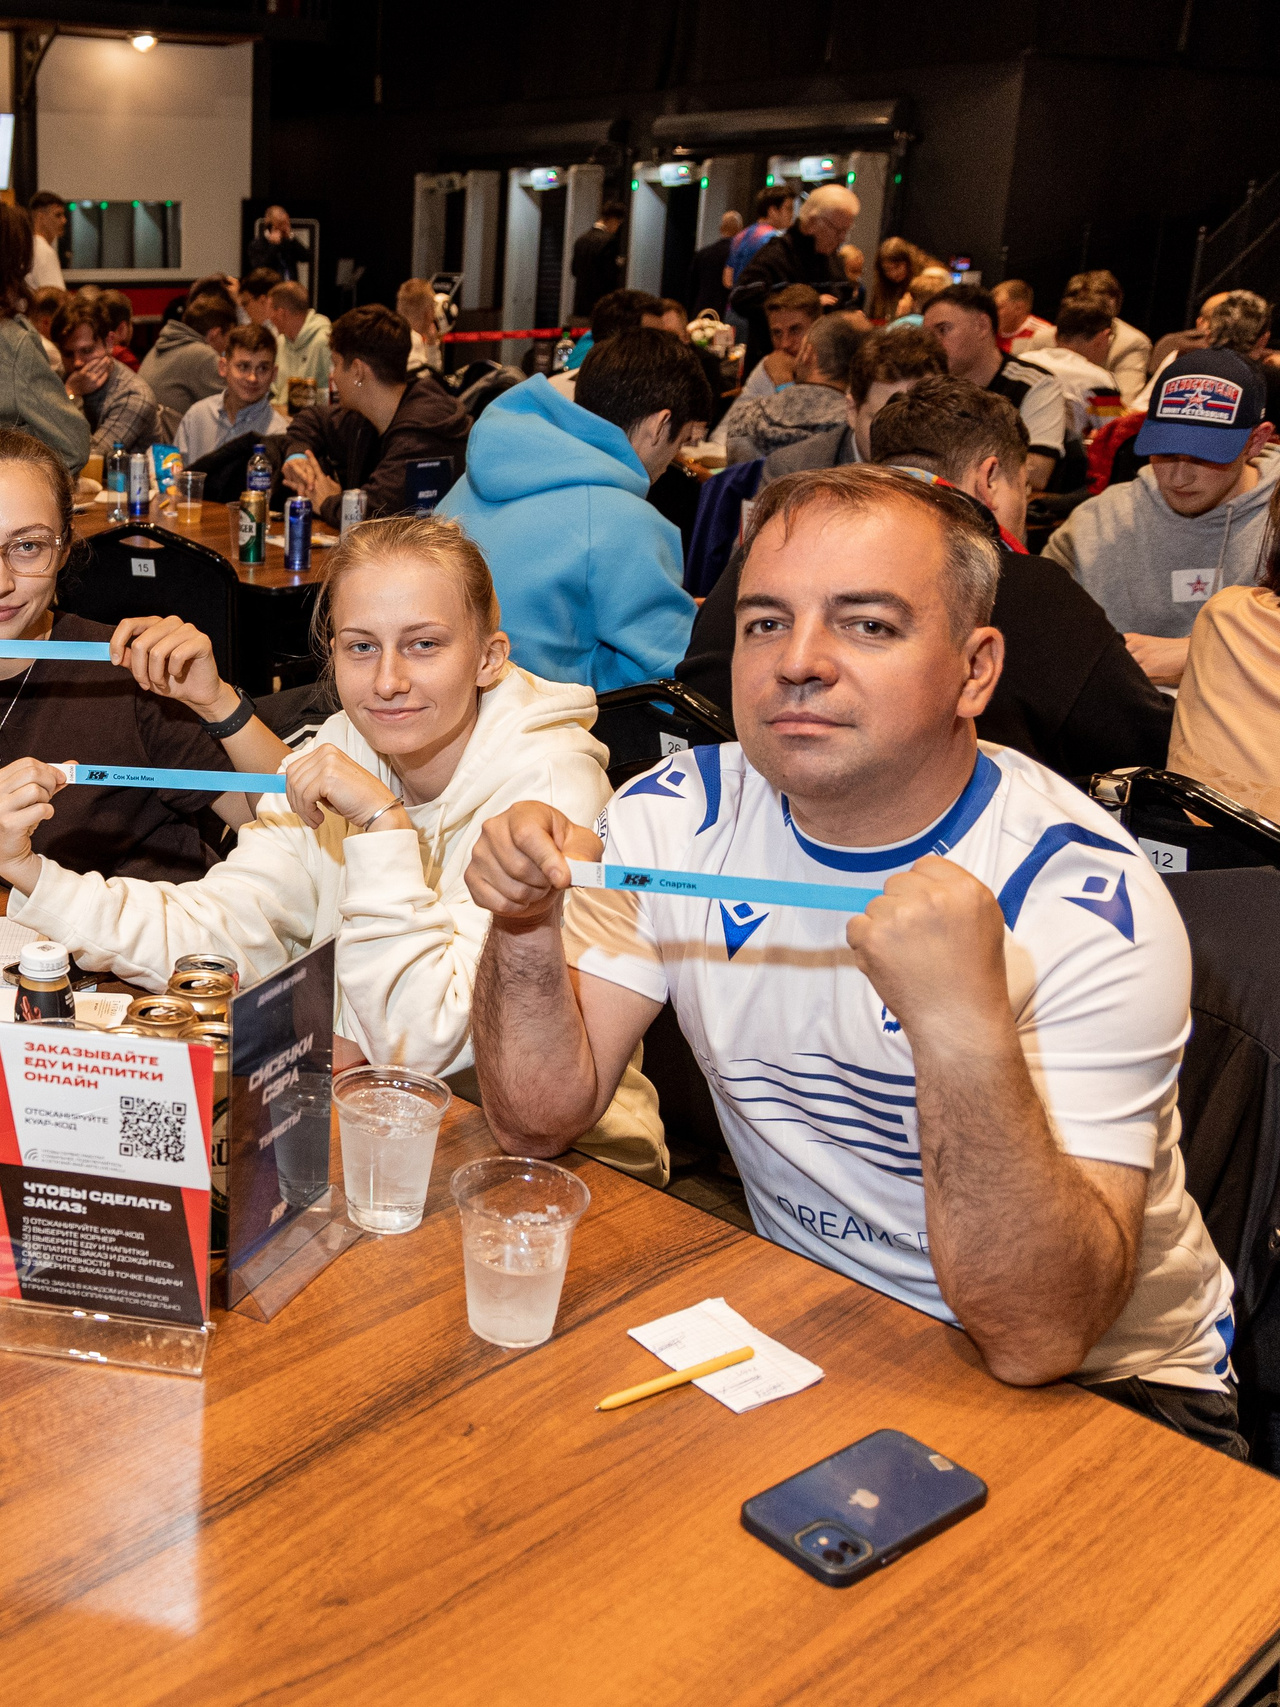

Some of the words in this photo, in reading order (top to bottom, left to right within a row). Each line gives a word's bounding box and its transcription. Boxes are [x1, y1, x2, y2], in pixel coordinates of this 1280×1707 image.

[138, 563, 149, 572] 15
[668, 742, 681, 754] 26
[1151, 850, 1173, 868] 12
[659, 879, 697, 890] Спартак
[24, 1042, 159, 1066] ЗАКАЗЫВАЙТЕ
[24, 1057, 61, 1069] ЕДУ
[62, 1062, 73, 1071] И
[77, 1063, 163, 1082] НАПИТКИ
[24, 1071, 99, 1090] ОНЛАЙН
[262, 1066, 300, 1105] СЭРА
[24, 1107, 109, 1125] ОТСКАНИРУЙТЕ
[24, 1117, 77, 1131] КУАР-КОД
[23, 1181, 87, 1200] ЧТОБЫ
[89, 1191, 172, 1212] СДЕЛАТЬ
[23, 1196, 88, 1215] ЗАКАЗ:
[29, 1217, 100, 1233] ОТСКАНИРУЙТЕ
[100, 1227, 145, 1241] КУАР-КОД
[32, 1226, 79, 1237] ВЫБЕРИТЕ
[80, 1233, 116, 1243] КОРНЕР
[32, 1236, 79, 1247] ВЫБЕРИТЕ
[80, 1241, 98, 1250] ЕДУ
[106, 1245, 149, 1257] НАПИТКИ
[32, 1244, 79, 1255] ОПЛАТИТЕ
[79, 1250, 108, 1260] ЗАКАЗ
[109, 1253, 117, 1261] И
[117, 1254, 175, 1270] ДОЖДИТЕСЬ
[51, 1253, 110, 1268] ГОТОВНОСТИ
[51, 1279, 76, 1289] ЗАКАЗ
[77, 1265, 107, 1276] ЗАКАЗ
[108, 1269, 115, 1277] В
[115, 1270, 144, 1282] ТОЧКЕ
[145, 1275, 184, 1287] ВЫДАЧИ
